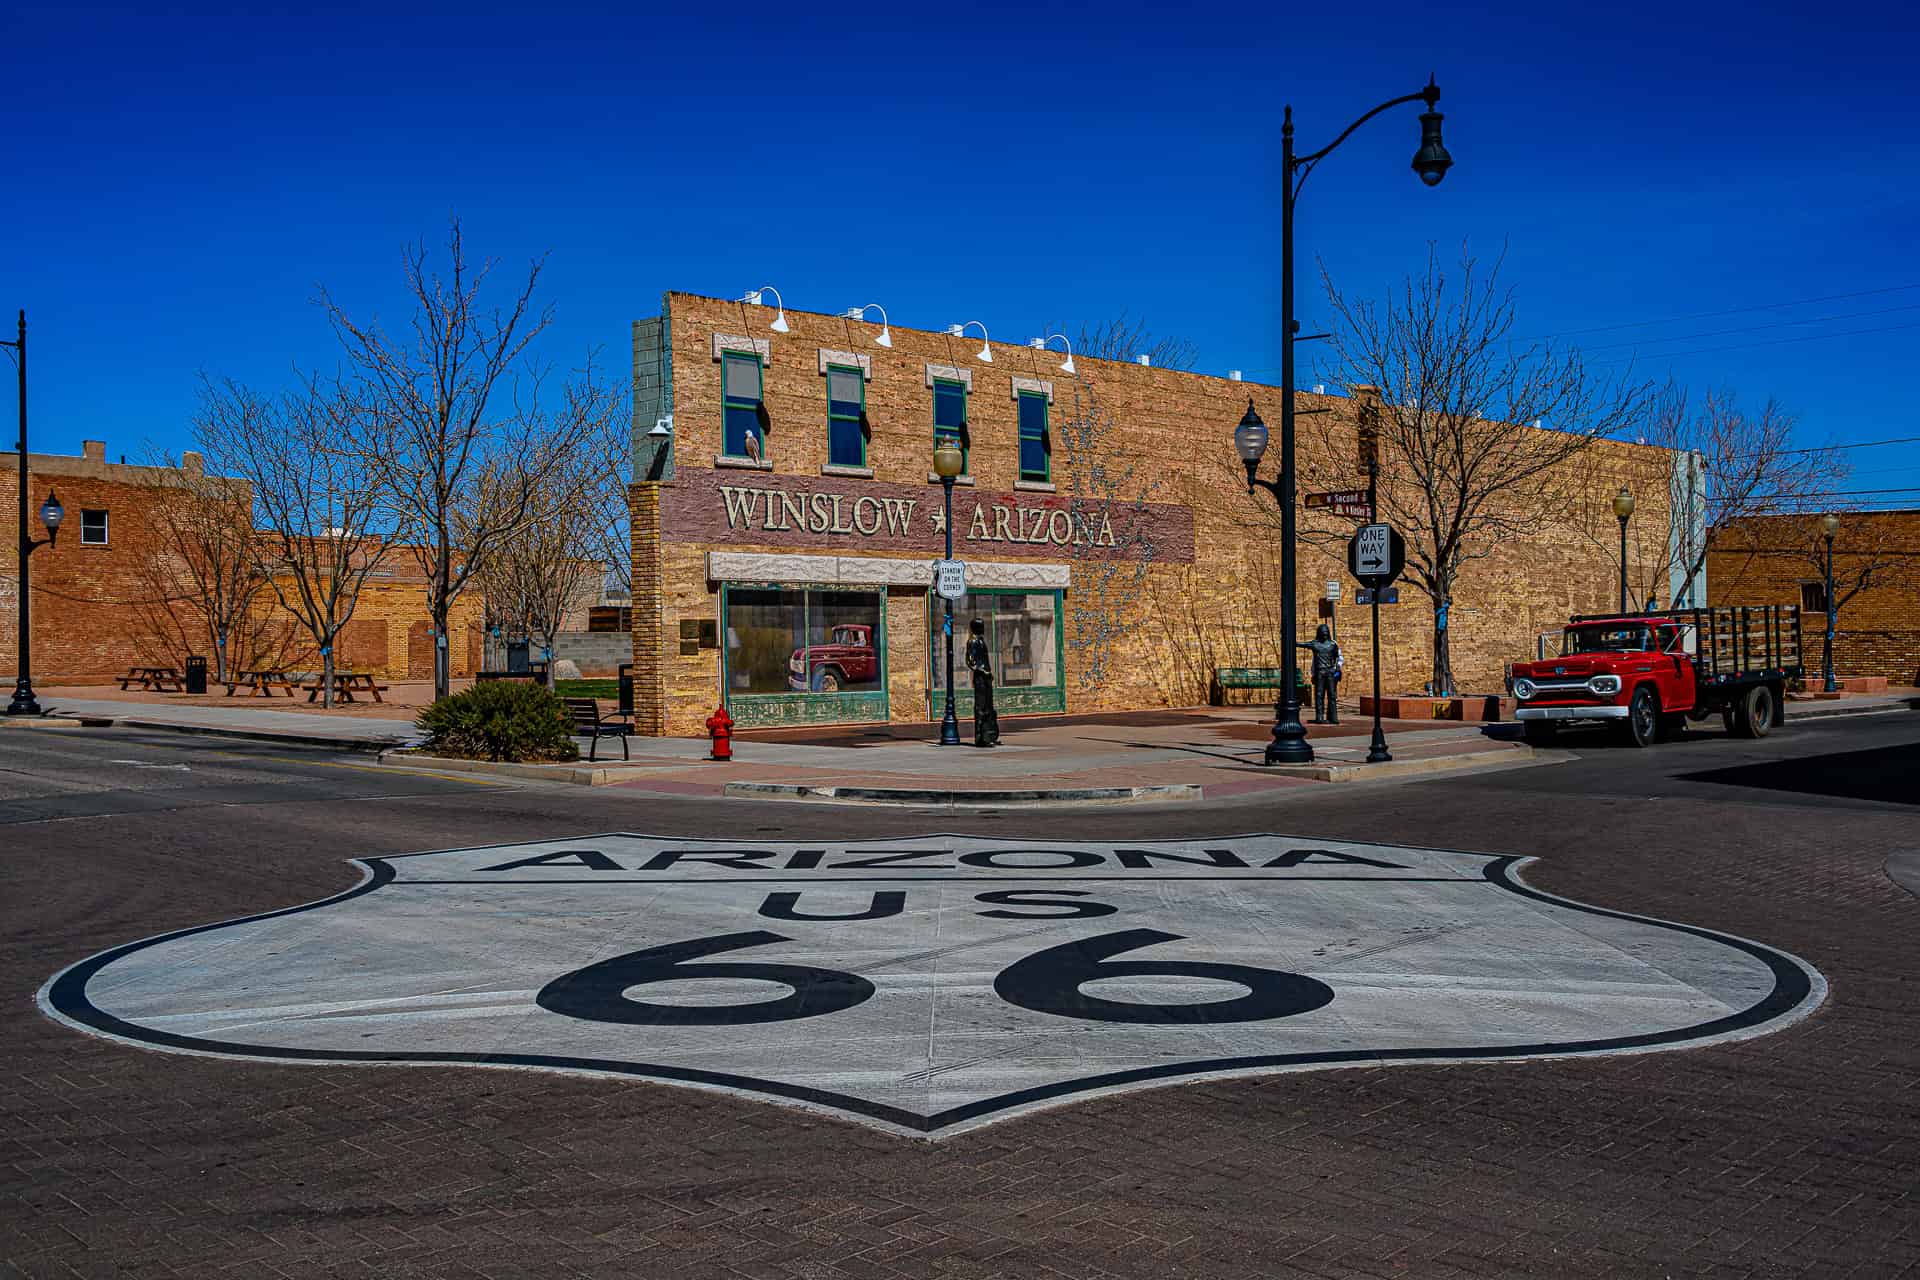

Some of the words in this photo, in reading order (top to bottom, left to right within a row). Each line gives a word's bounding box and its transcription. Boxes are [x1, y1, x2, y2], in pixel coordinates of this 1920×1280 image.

[719, 486, 918, 537] WINSLOW
[966, 502, 1117, 547] ARIZONA
[1361, 528, 1385, 541] ONE
[1360, 543, 1385, 554] WAY
[472, 850, 1416, 871] ARIZONA
